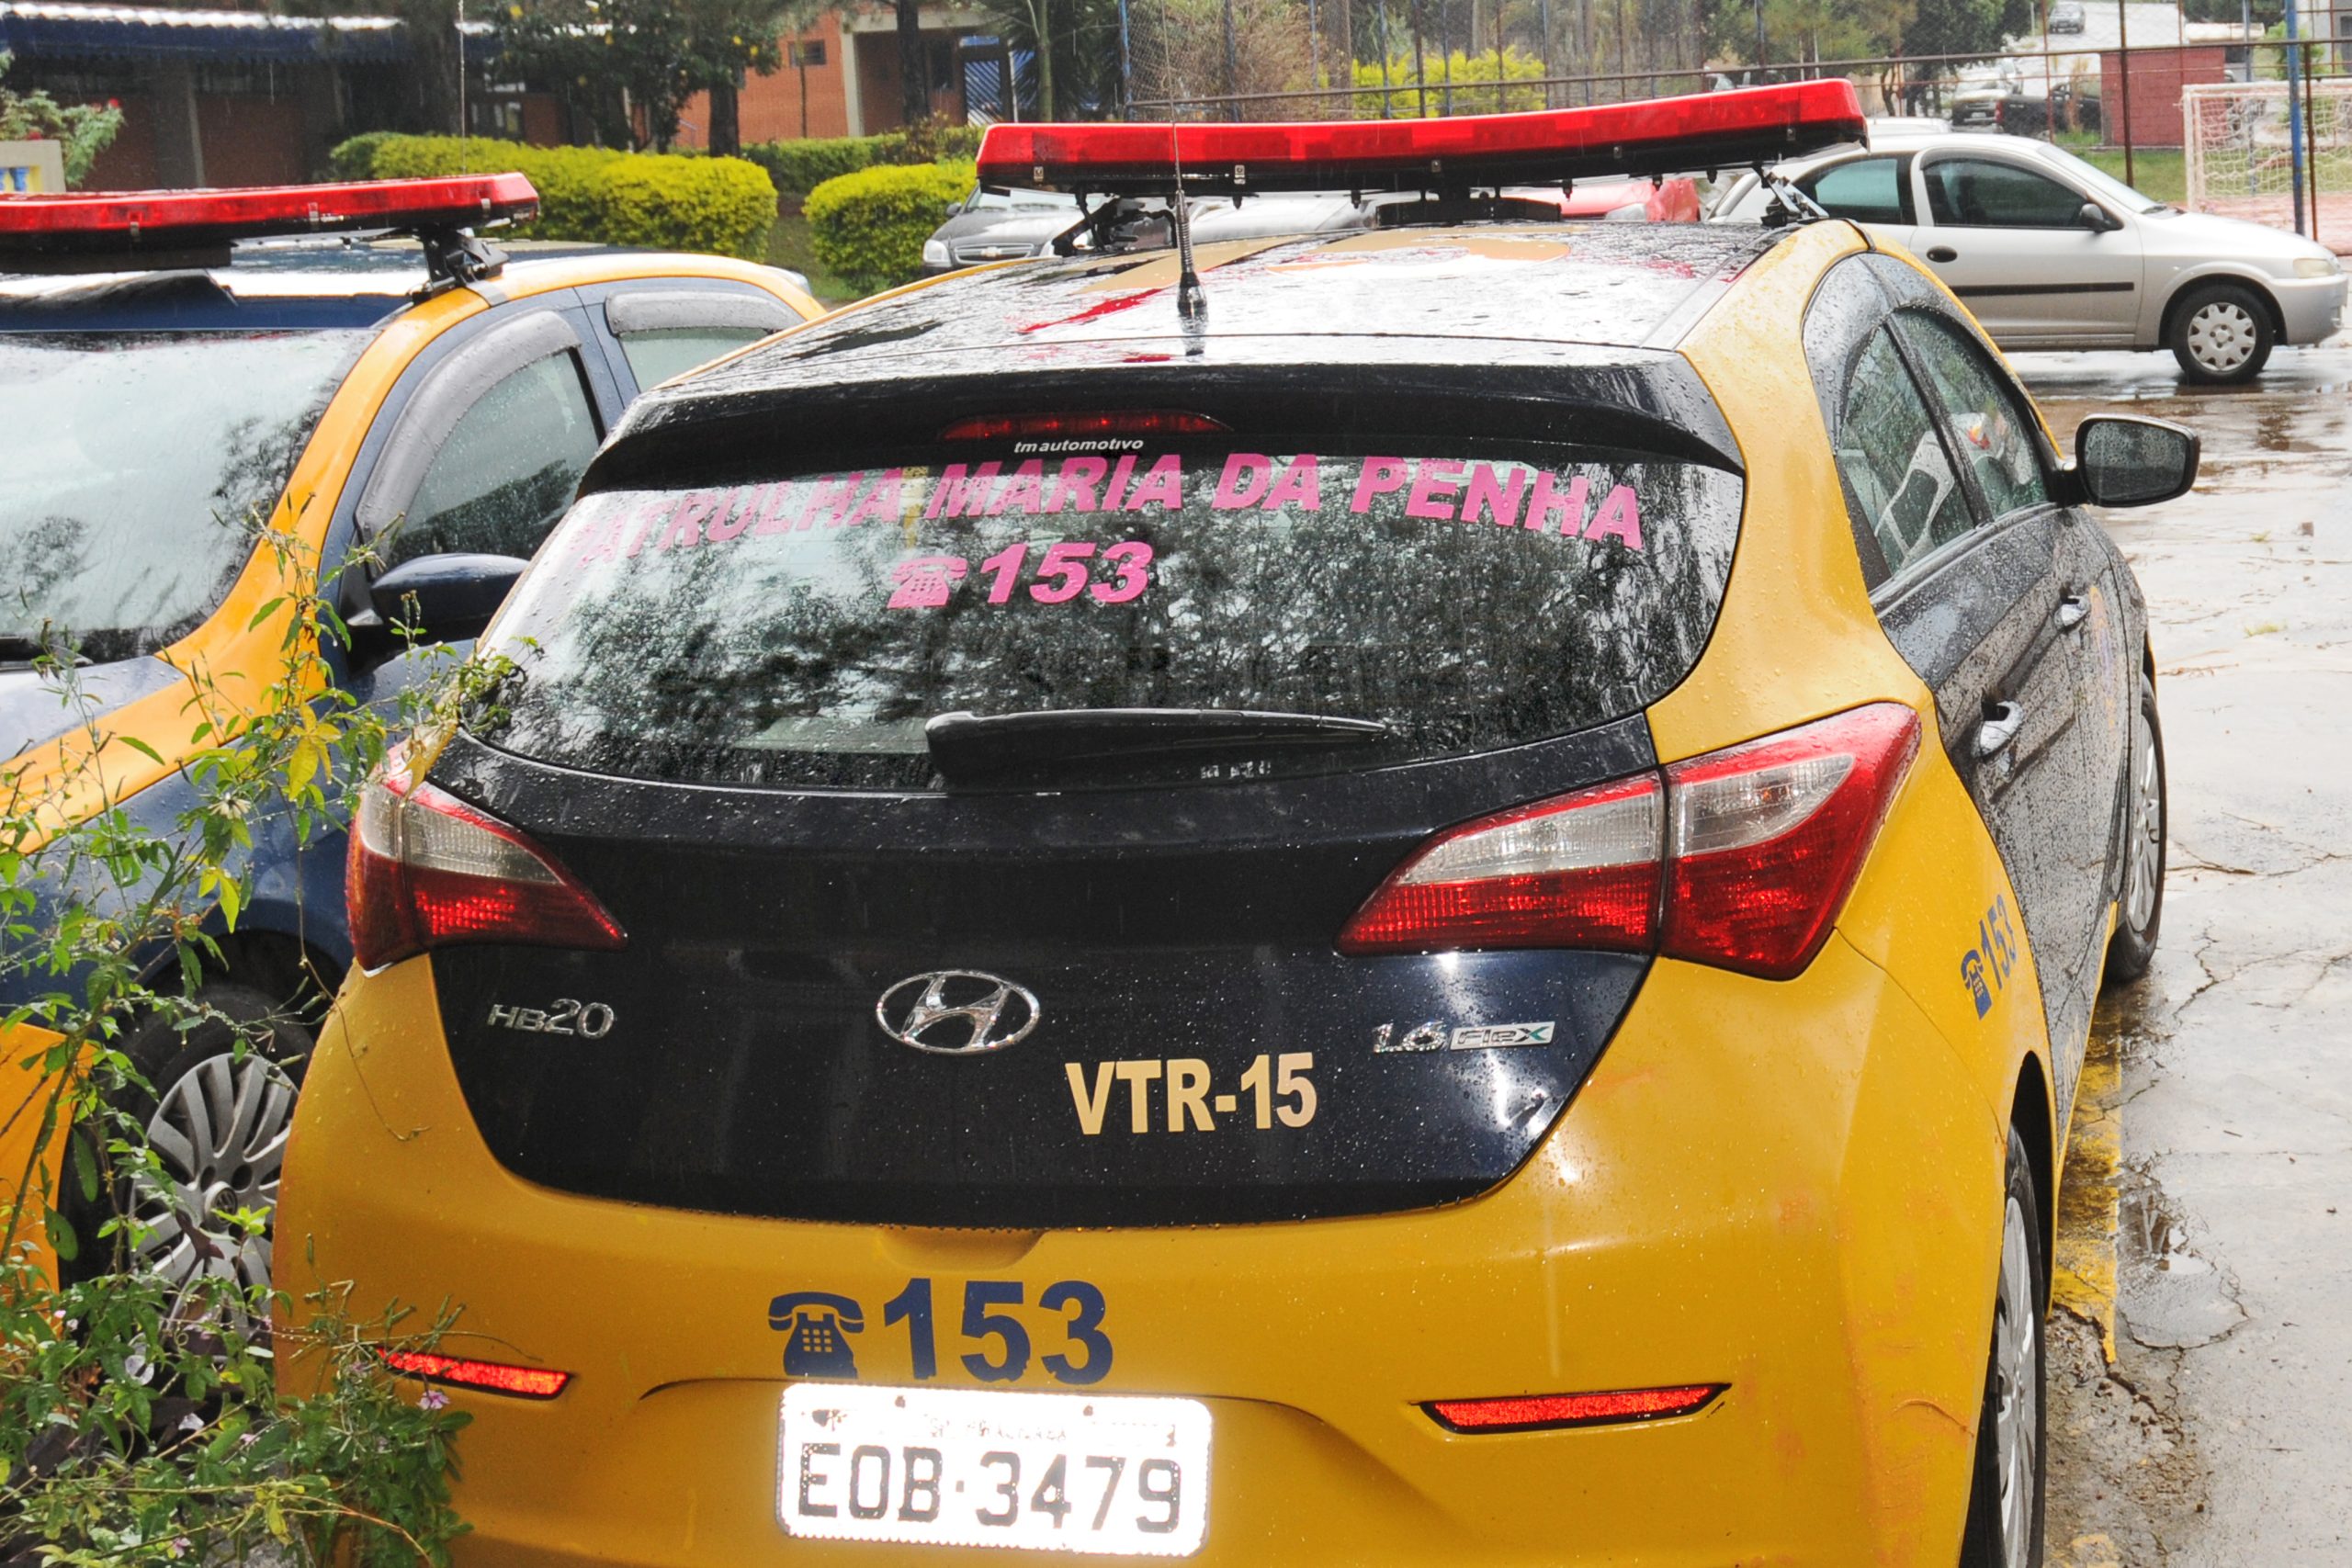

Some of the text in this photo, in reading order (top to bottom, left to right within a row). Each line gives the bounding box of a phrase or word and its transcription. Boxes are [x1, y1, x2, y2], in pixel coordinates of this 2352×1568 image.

[924, 451, 1183, 520] MARIA
[1211, 452, 1321, 512] DA
[1350, 455, 1644, 550] PENHA
[979, 540, 1155, 604] 153
[1978, 894, 2017, 990] 153
[486, 998, 616, 1041] HB20
[1064, 1051, 1318, 1136] VTR-15
[883, 1278, 1114, 1385] 153
